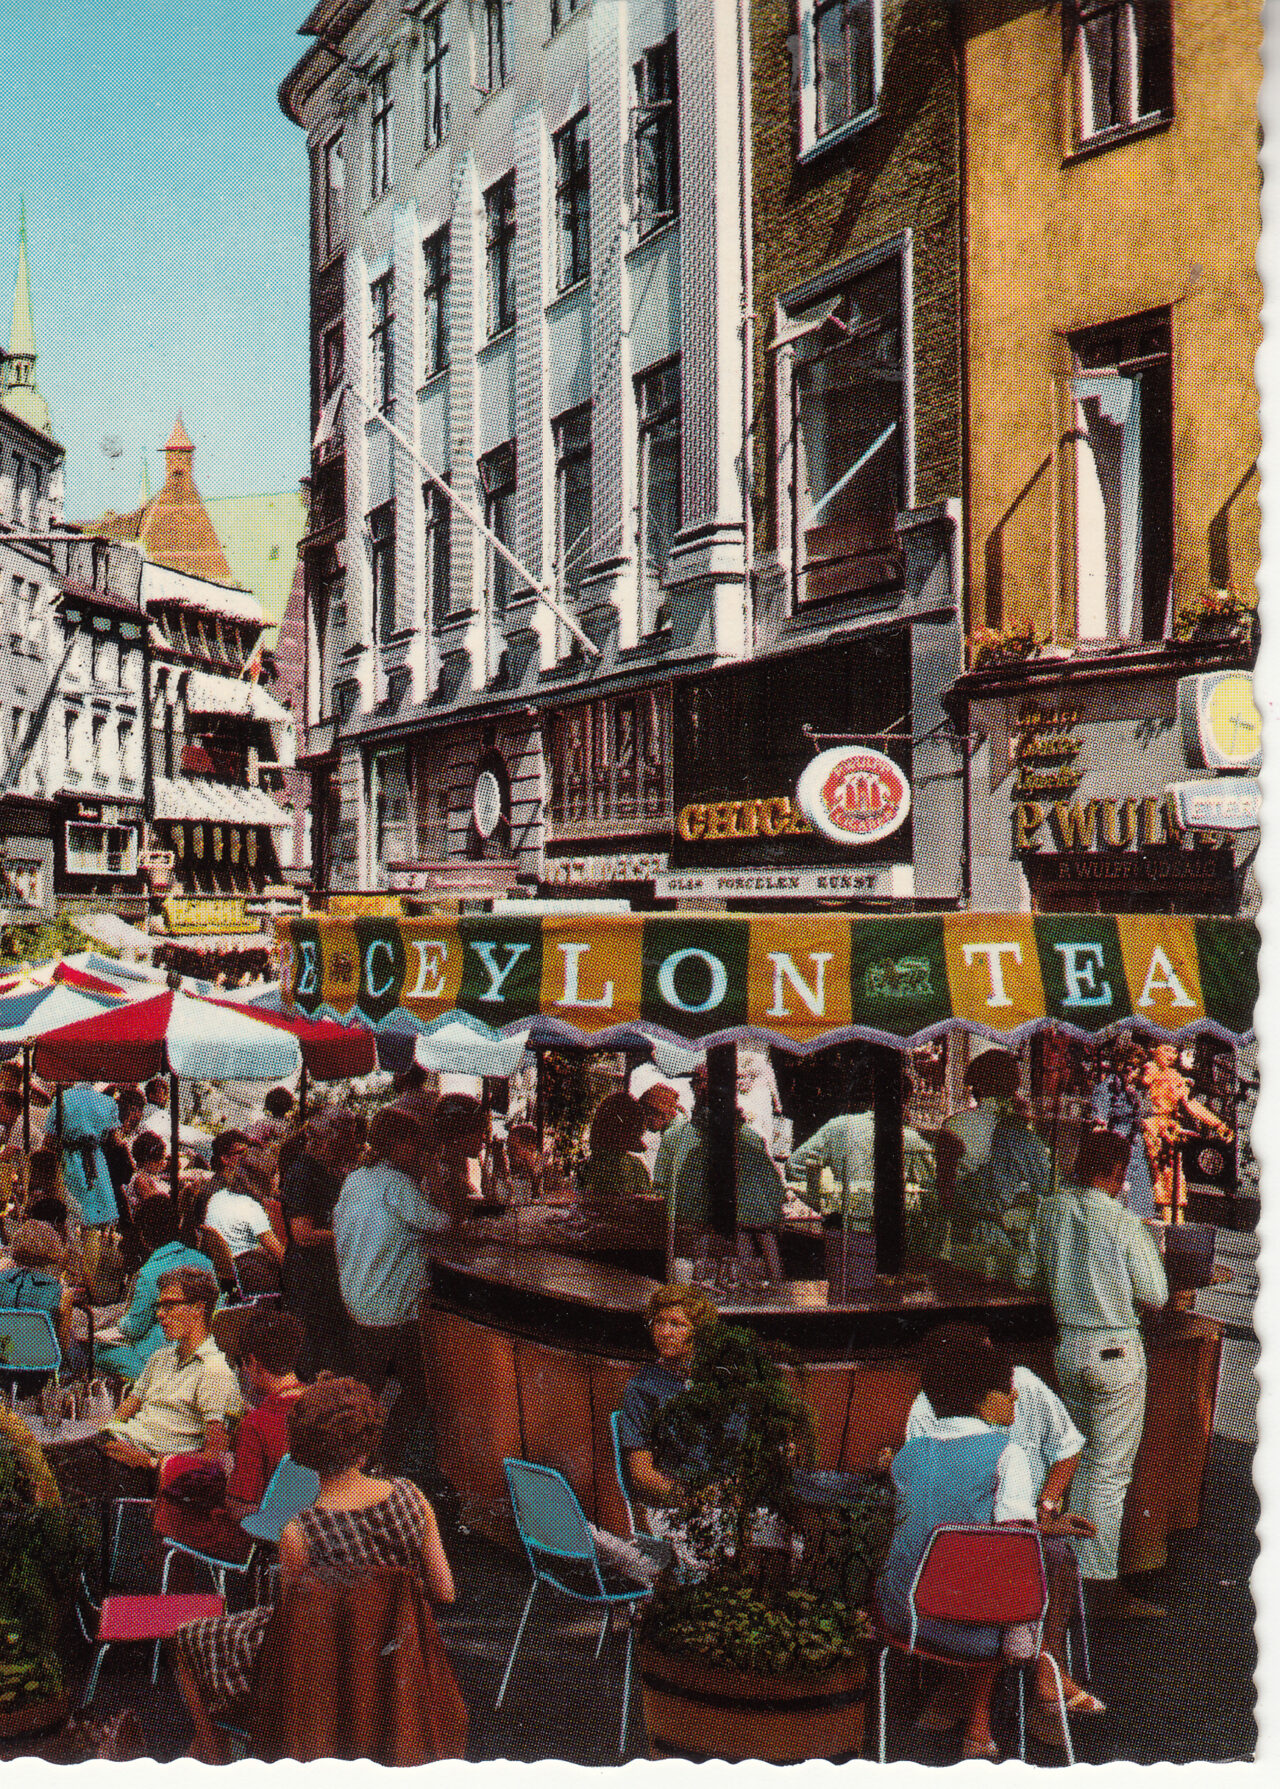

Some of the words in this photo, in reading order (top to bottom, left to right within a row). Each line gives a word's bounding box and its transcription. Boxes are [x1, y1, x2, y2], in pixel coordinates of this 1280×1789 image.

[677, 796, 813, 841] CHICA
[1191, 794, 1260, 818] ETER
[365, 939, 832, 1017] CEYLON
[963, 941, 1197, 1008] TEA
